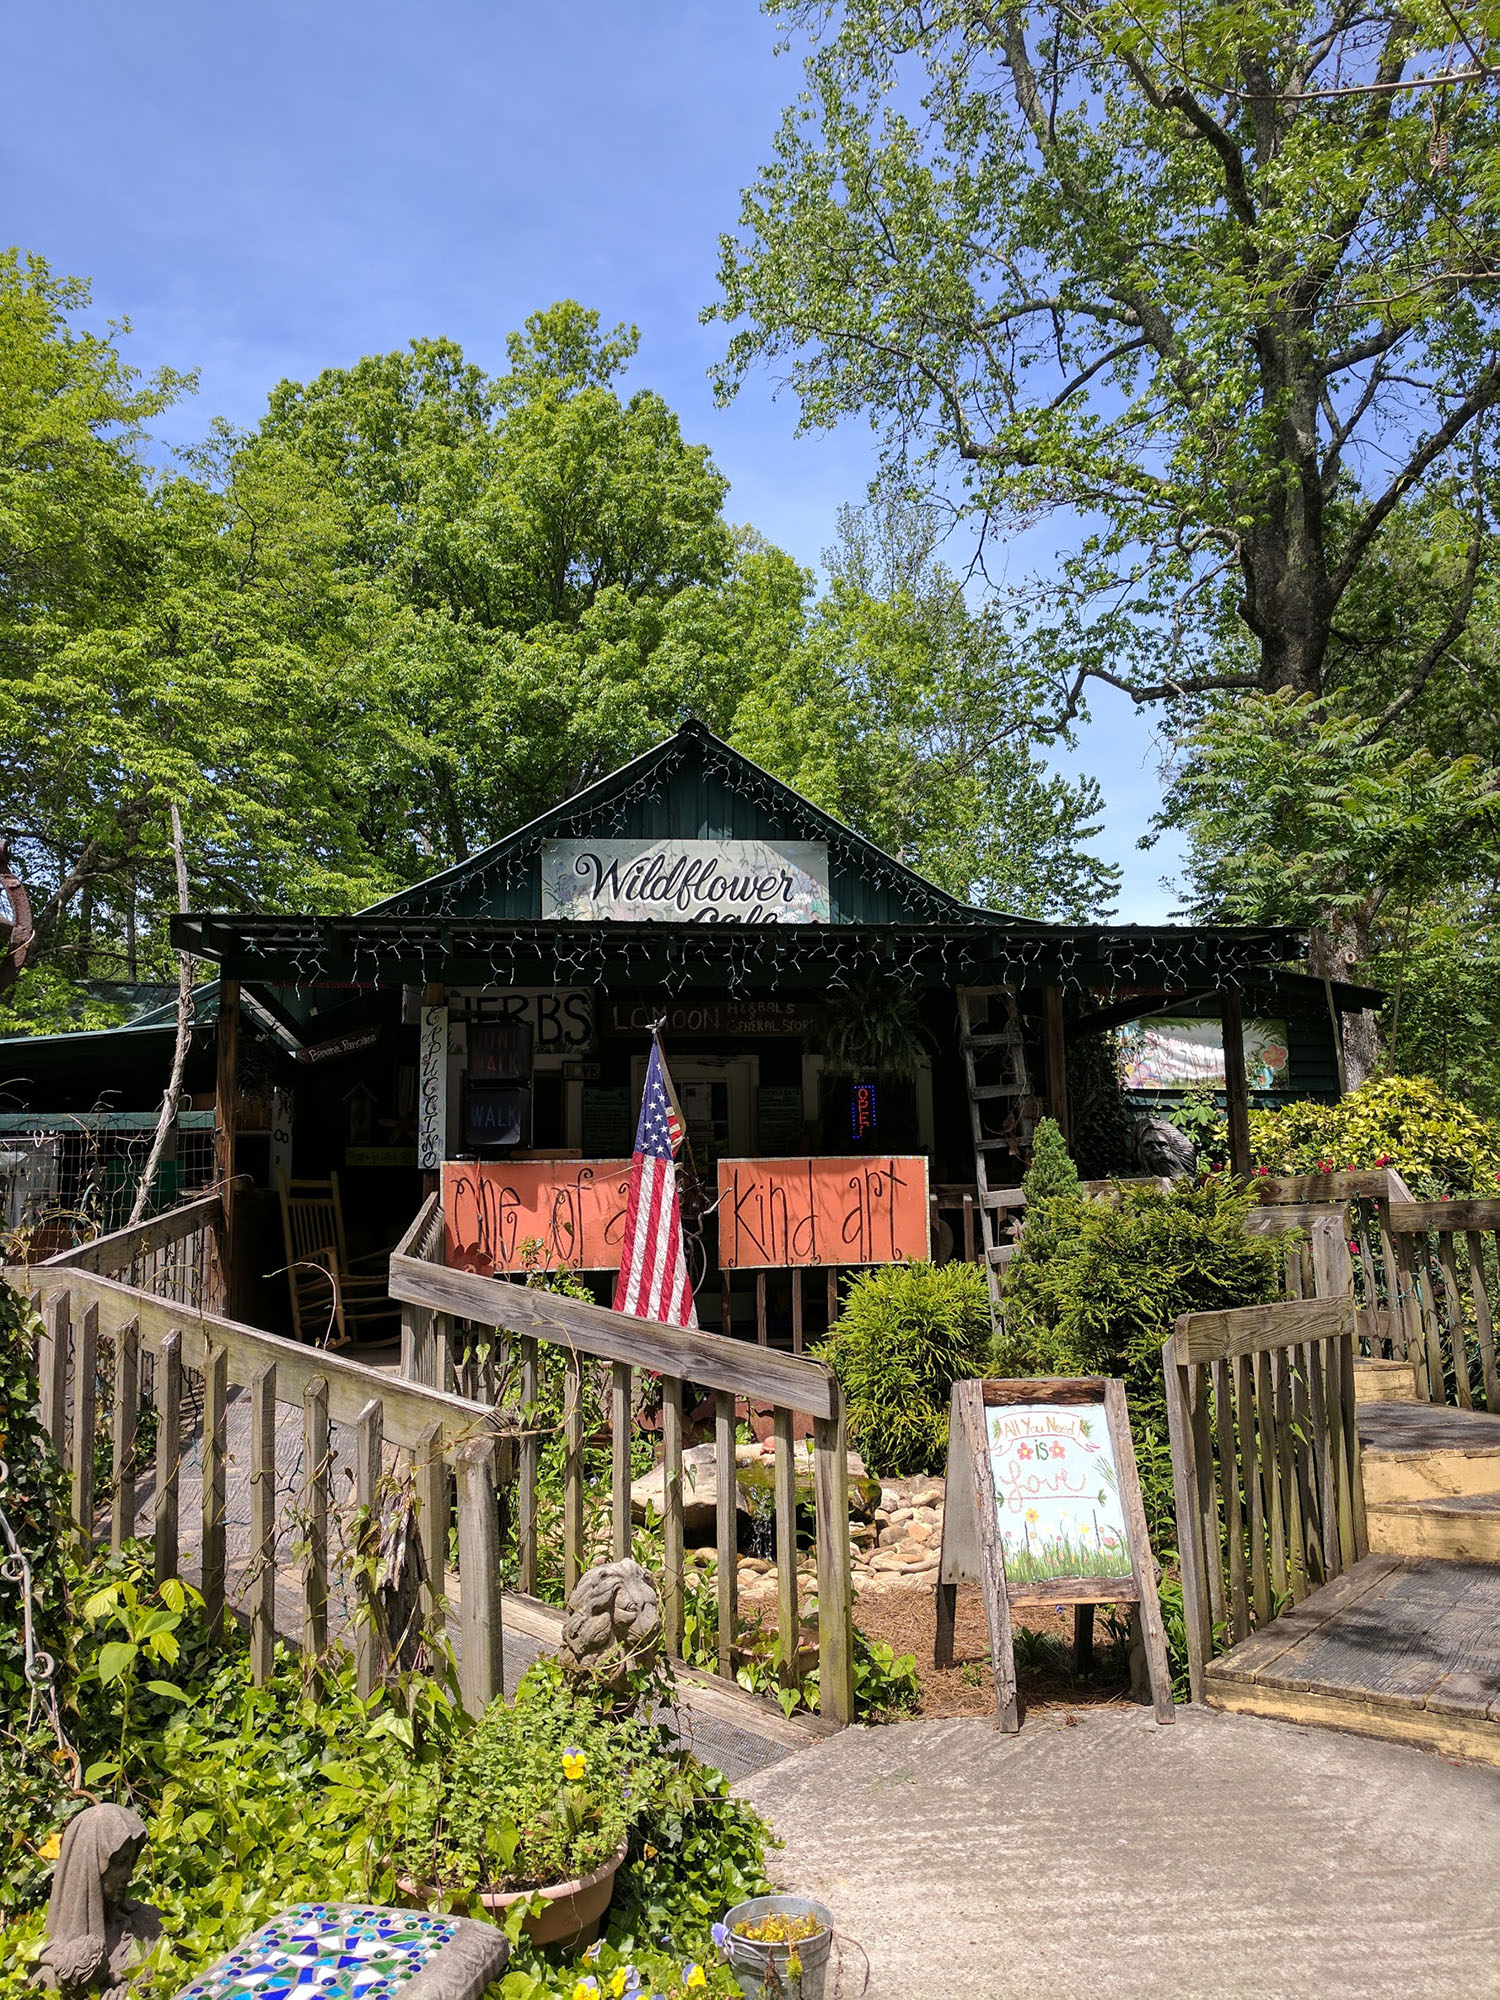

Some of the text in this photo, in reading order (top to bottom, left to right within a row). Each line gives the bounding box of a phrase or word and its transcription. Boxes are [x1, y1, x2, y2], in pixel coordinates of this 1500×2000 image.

[574, 852, 795, 912] Wildflower
[308, 1033, 377, 1063] Banana Pancakes
[471, 1104, 518, 1127] WALK
[551, 1168, 594, 1268] of
[842, 1160, 908, 1262] art
[1004, 1416, 1075, 1438] All You Need
[1034, 1439, 1049, 1461] is
[999, 1459, 1087, 1514] Love
